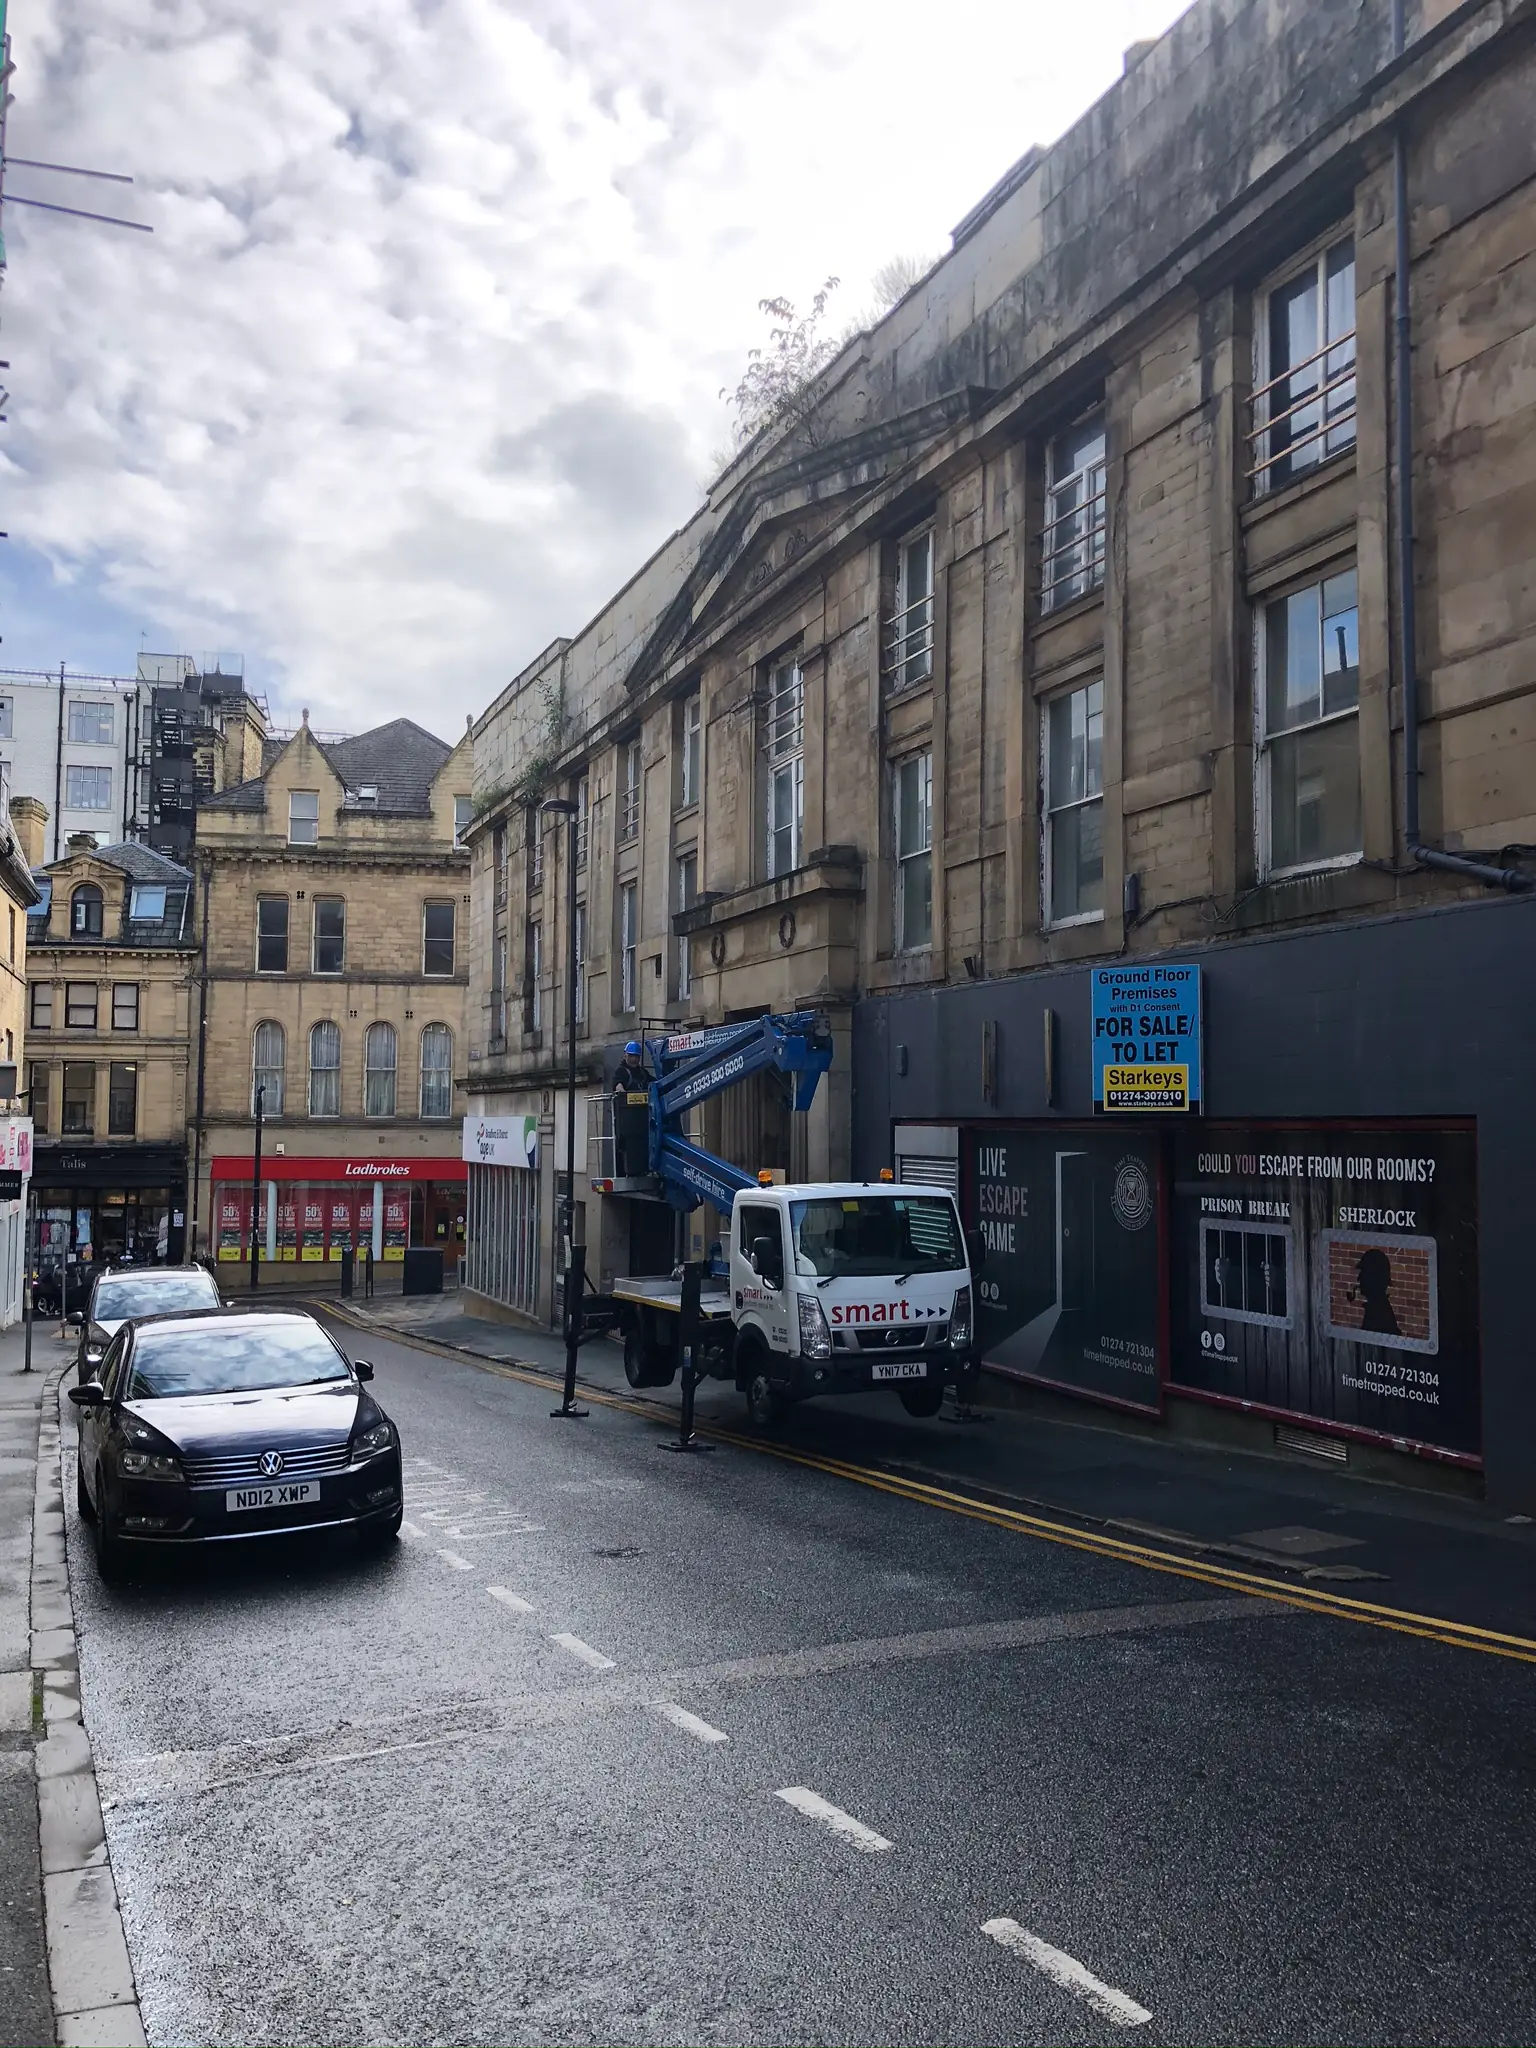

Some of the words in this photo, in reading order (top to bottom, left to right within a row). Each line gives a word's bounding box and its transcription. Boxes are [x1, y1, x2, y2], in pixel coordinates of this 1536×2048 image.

[1099, 970, 1150, 984] Ground
[1154, 968, 1191, 982] Floor
[1111, 986, 1177, 1000] Premises
[1110, 1004, 1128, 1013] with
[1130, 1004, 1141, 1012] D1
[1144, 1002, 1180, 1012] Consent
[1095, 1016, 1133, 1037] FOR
[1139, 1014, 1195, 1037] SALE/
[668, 1035, 692, 1051] smart
[1111, 1042, 1137, 1063] TO
[1144, 1041, 1179, 1062] LET
[693, 1074, 711, 1093] 0333
[711, 1066, 724, 1084] 800
[1109, 1069, 1183, 1088] Starkeys
[1110, 1091, 1182, 1100] 01274-307910
[480, 1143, 489, 1160] age
[60, 1159, 87, 1169] Talis
[345, 1163, 410, 1175] Ladbrokes
[979, 1147, 1007, 1177] LIVE
[1198, 1153, 1231, 1174] COULD
[1234, 1154, 1256, 1175] YOU
[1259, 1154, 1304, 1177] ESCAPE
[1307, 1156, 1343, 1178] FROM
[1346, 1157, 1373, 1180] OUR
[1377, 1158, 1436, 1182] ROOMS?
[683, 1167, 711, 1190] self-drive
[711, 1180, 725, 1199] hire
[979, 1183, 1028, 1217] ESCAPE
[1201, 1197, 1243, 1214] PRISON
[1248, 1200, 1291, 1217] BREAK
[222, 1206, 239, 1217] 50%
[278, 1206, 295, 1217] 50%
[305, 1206, 322, 1217] 50%
[332, 1206, 349, 1217] 50%
[387, 1206, 404, 1217] 50%
[1339, 1206, 1416, 1227] SHERLOCK
[743, 1287, 763, 1299] smart
[831, 1299, 910, 1324] smart
[1101, 1335, 1124, 1351] 01274
[1126, 1341, 1155, 1359] 721304
[878, 1364, 900, 1377] YN17
[902, 1363, 921, 1376] CKA
[1083, 1347, 1155, 1376] timetrapped.co.uk
[1365, 1361, 1397, 1379] 01274
[1399, 1367, 1440, 1387] 721304
[1342, 1373, 1440, 1405] timetrapped.co.uk
[236, 1489, 273, 1508] ND12
[278, 1485, 310, 1503] XWP
